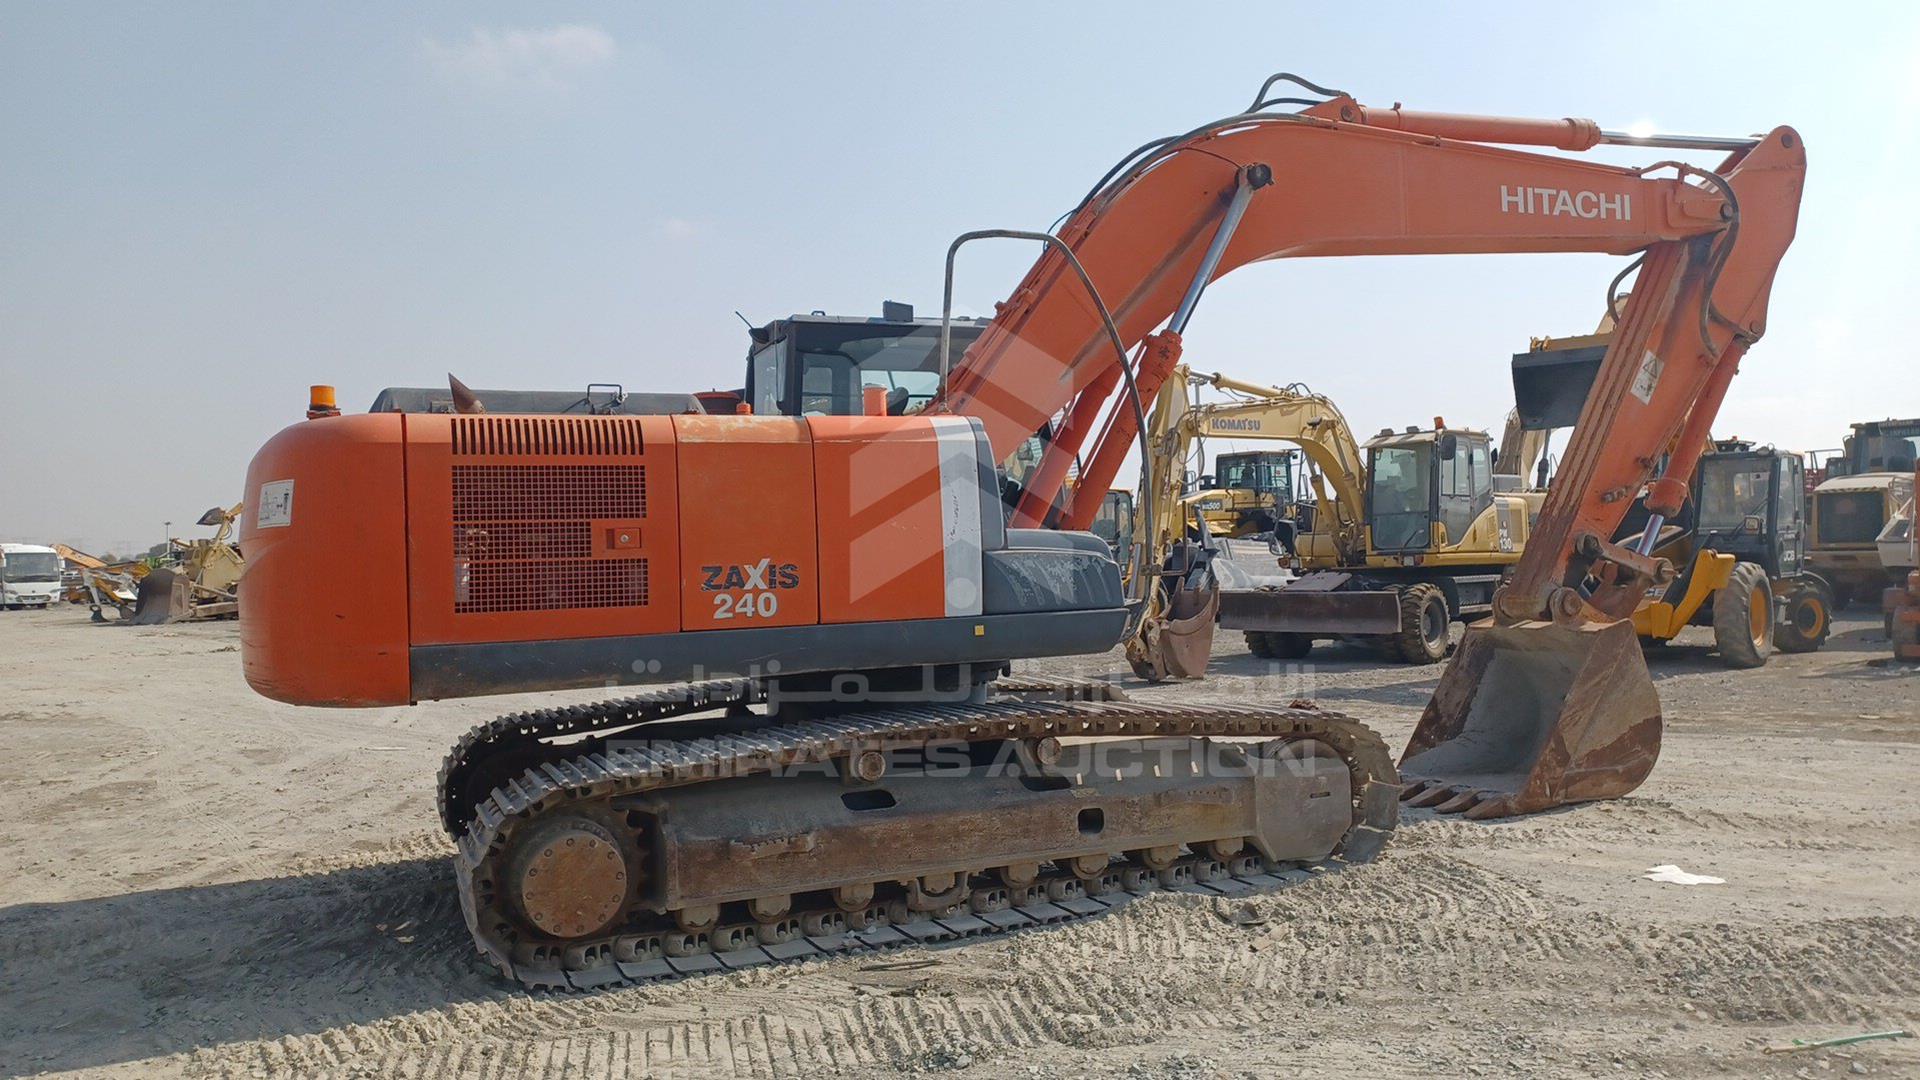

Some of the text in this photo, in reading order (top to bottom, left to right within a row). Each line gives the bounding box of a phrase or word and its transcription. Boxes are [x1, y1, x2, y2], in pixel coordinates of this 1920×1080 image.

[1500, 185, 1631, 221] HITACHI
[1211, 418, 1261, 431] KOMATSU
[701, 558, 800, 591] ZAXIS
[713, 592, 777, 619] 240
